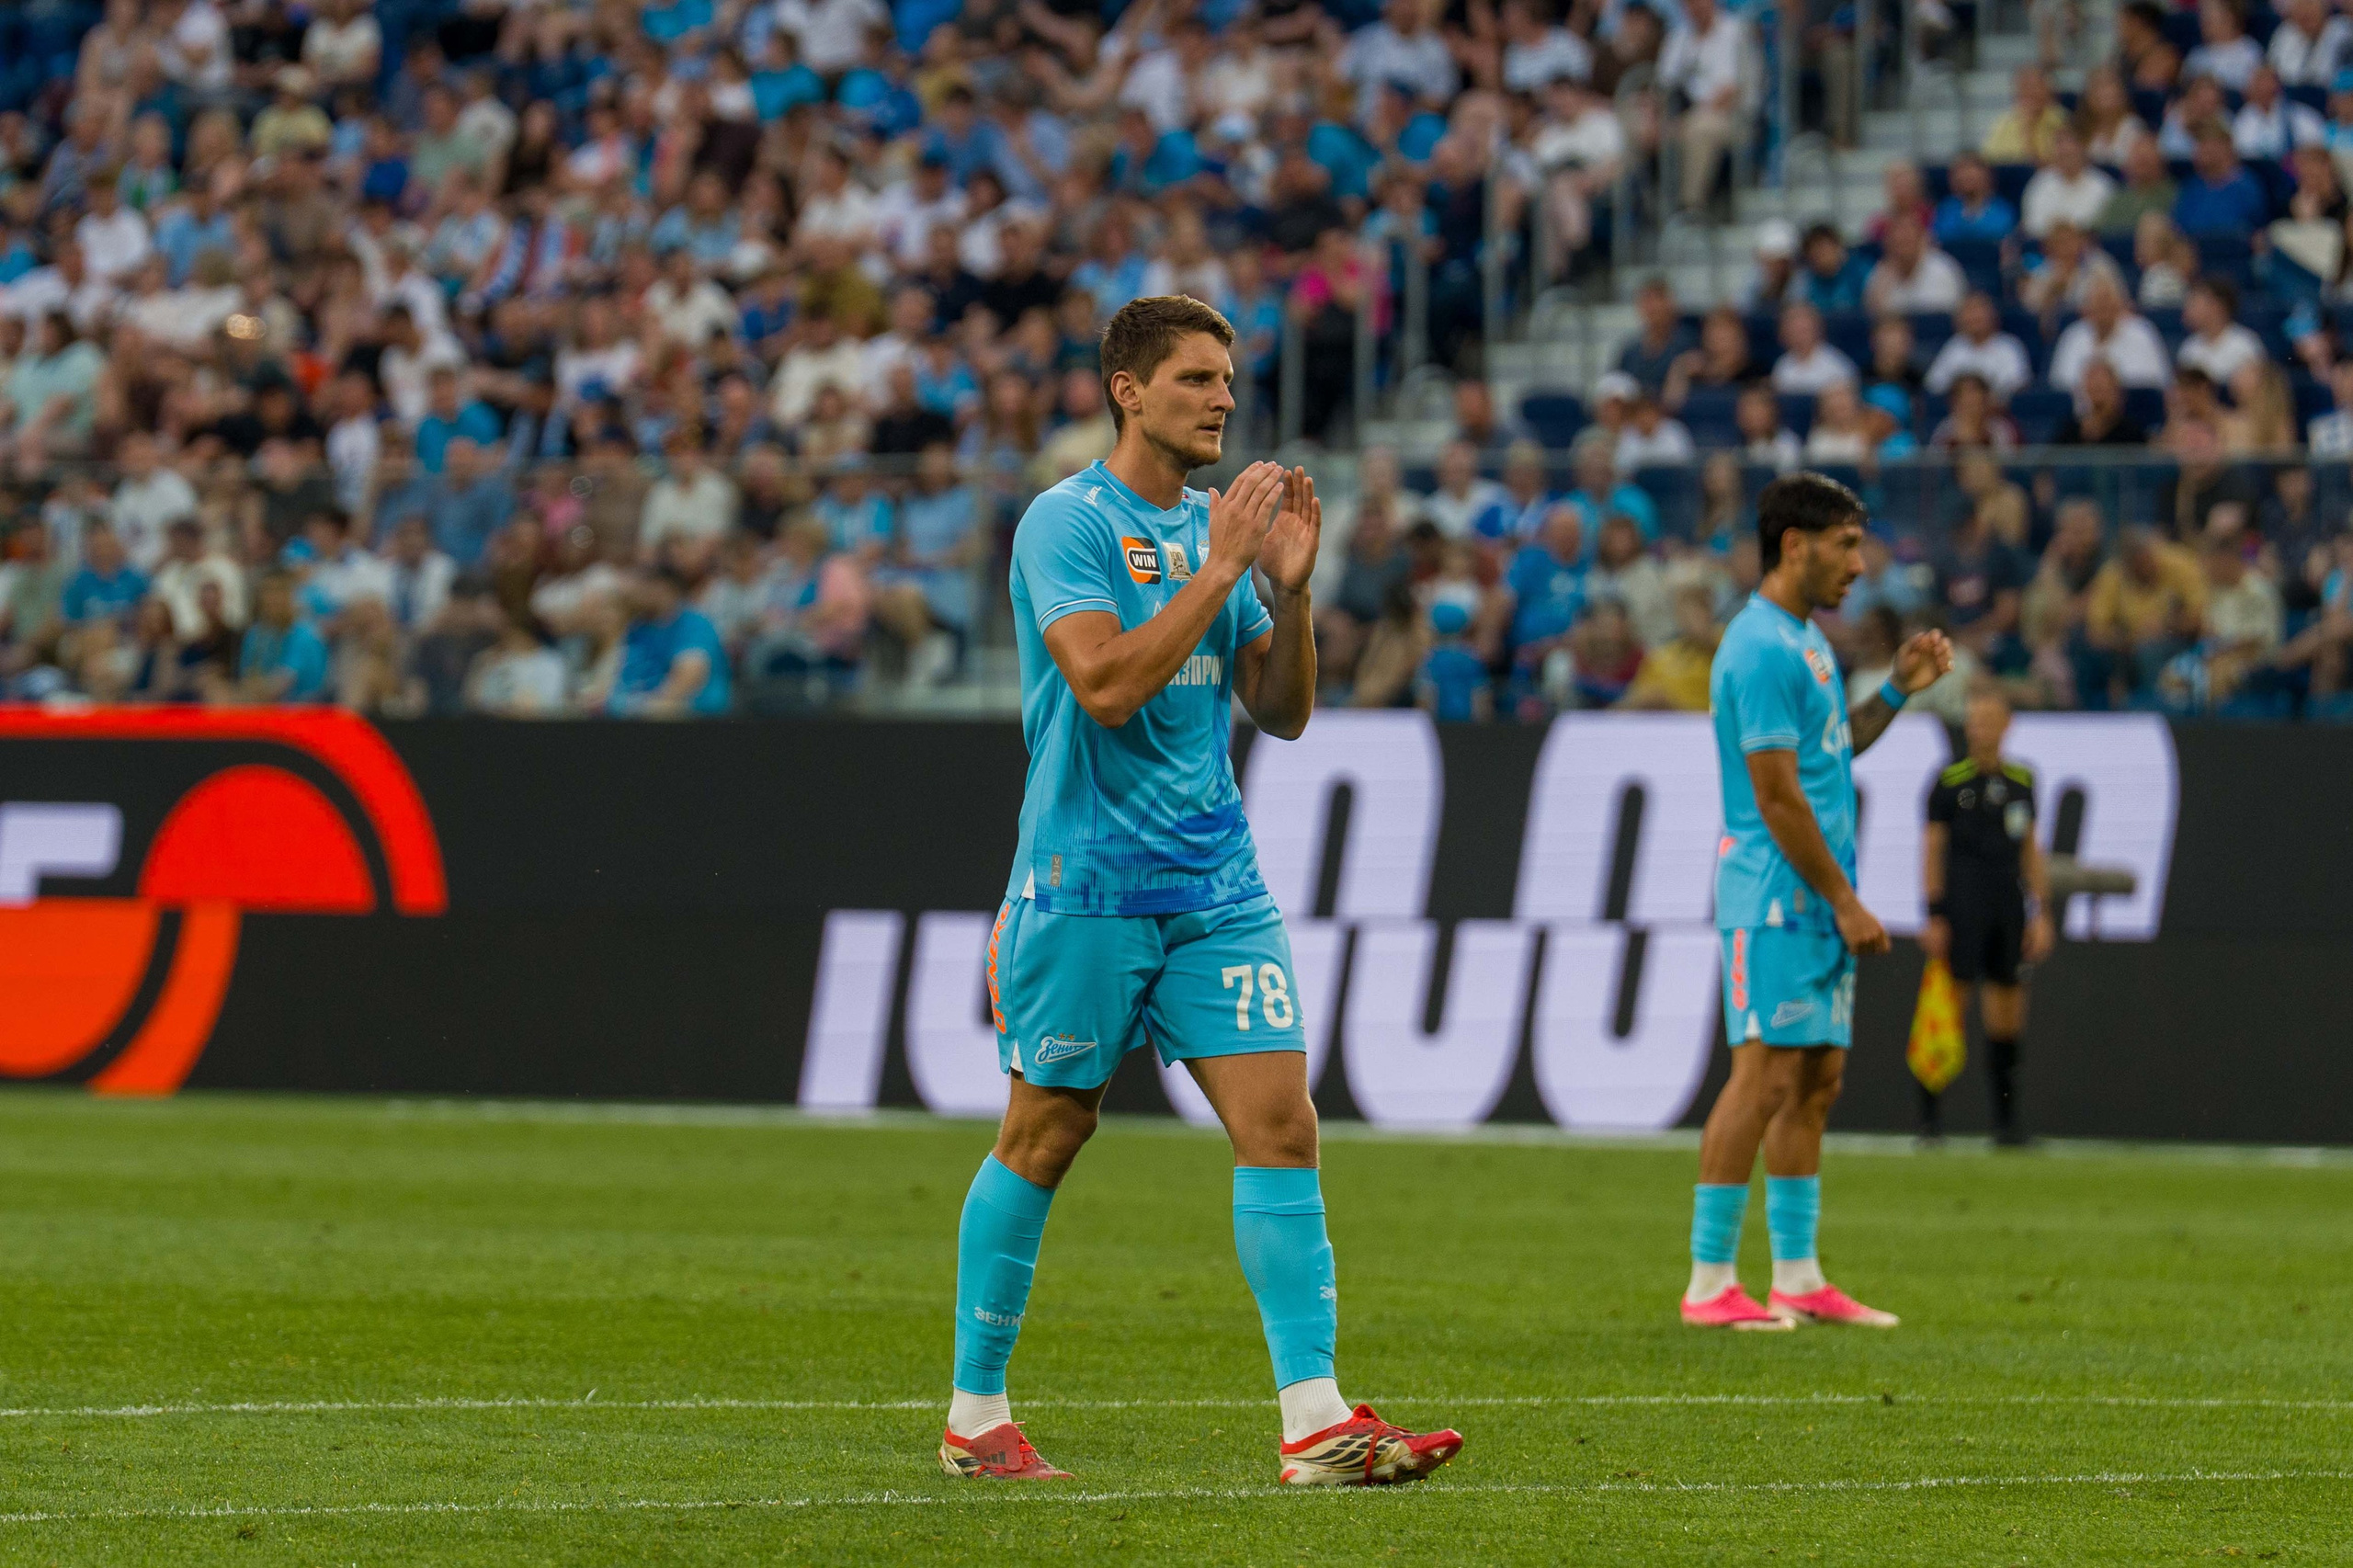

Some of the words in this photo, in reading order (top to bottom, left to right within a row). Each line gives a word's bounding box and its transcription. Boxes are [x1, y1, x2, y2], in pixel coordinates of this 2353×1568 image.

[1131, 553, 1156, 568] WIN
[1222, 963, 1294, 1032] 78
[974, 1306, 1025, 1327] ЗЕНИ
